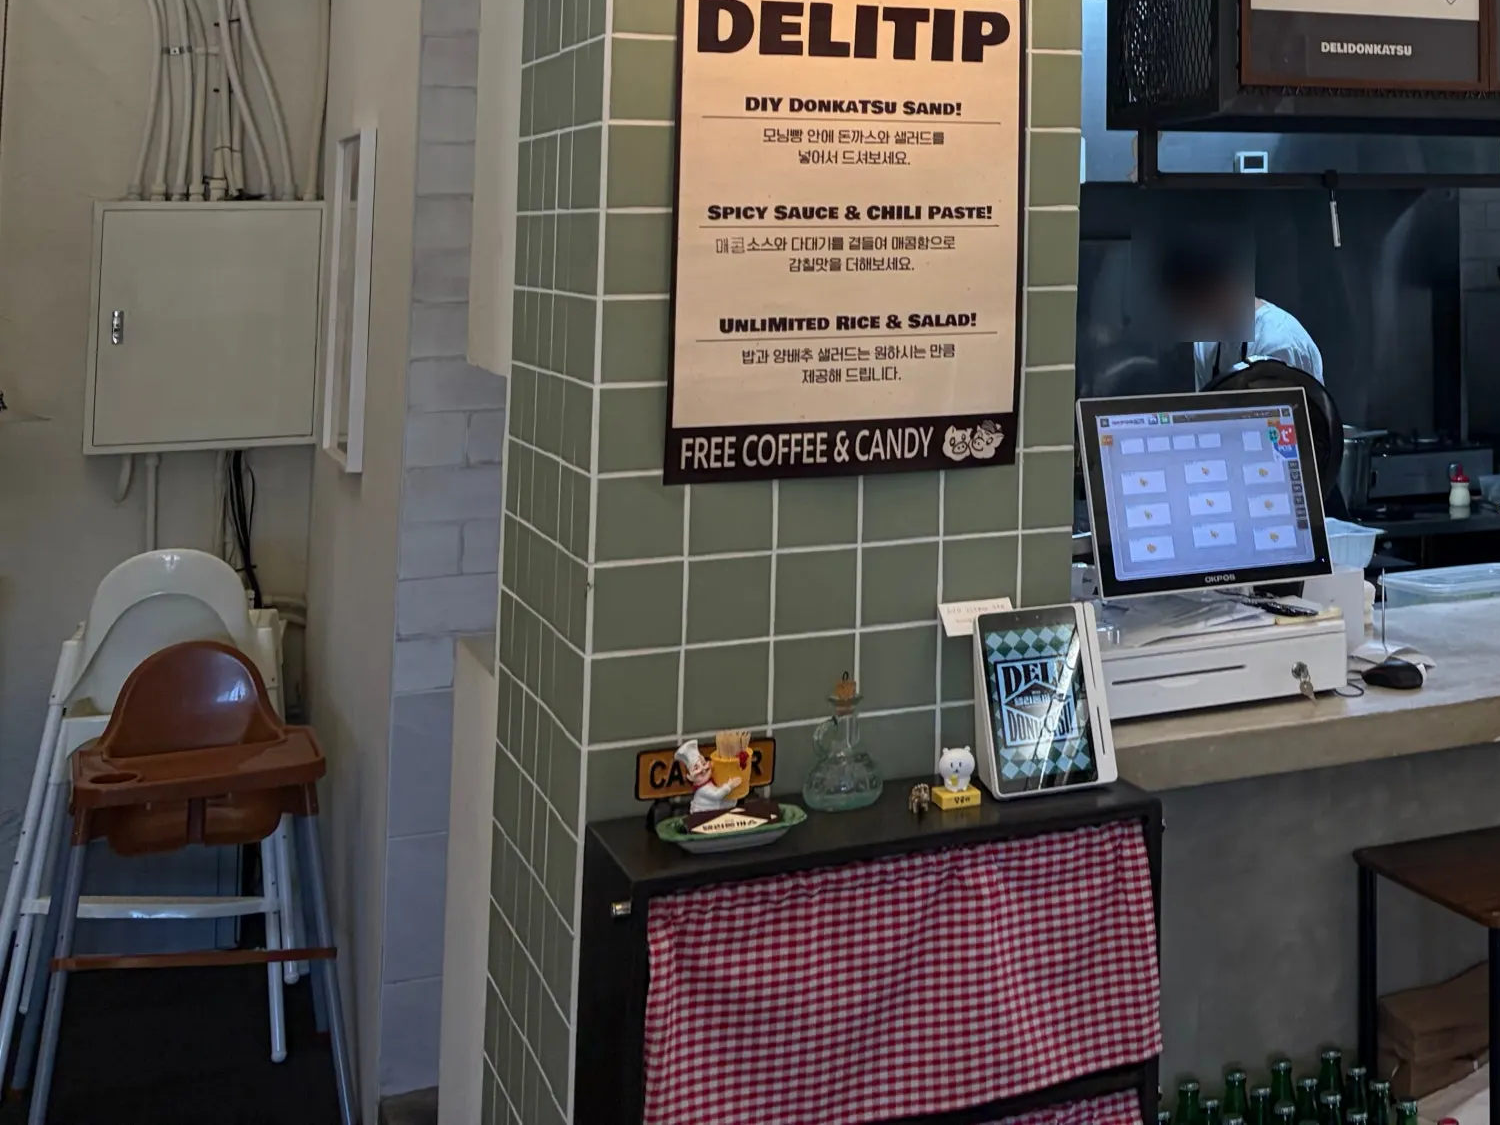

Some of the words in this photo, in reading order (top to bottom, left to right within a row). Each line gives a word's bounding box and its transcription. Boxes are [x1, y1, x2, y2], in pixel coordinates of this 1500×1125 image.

[1320, 41, 1413, 56] DELIDONKATSU
[745, 96, 784, 113] DIY
[789, 97, 897, 115] DONKATSU
[902, 101, 962, 116] SAND!
[762, 128, 804, 144] 모닝빵
[807, 128, 834, 144] 안에
[838, 129, 890, 145] 돈까스와
[894, 130, 945, 146] 샐러드를
[798, 149, 838, 165] 넣어서
[842, 150, 911, 166] 드셔보세요.
[708, 204, 768, 221] SPICY
[774, 204, 839, 221] SAUCE
[844, 204, 861, 221] &
[866, 205, 922, 221] CHILI
[928, 205, 993, 221] PASTE!
[791, 236, 844, 252] 다대기를
[848, 236, 888, 252] 곁들여
[788, 257, 842, 273] 감칠맛을
[846, 256, 915, 273] 더해보세요.
[719, 315, 830, 334] UNLIMITED
[836, 314, 880, 332] RICE
[886, 314, 902, 330] &
[908, 312, 977, 329] SALAD!
[741, 349, 769, 365] 밥과
[773, 348, 814, 364] 양배추
[818, 346, 871, 363] 샐러드는
[874, 345, 927, 361] 원하시는
[929, 344, 956, 360] 만큼
[801, 367, 842, 385] 제공해
[845, 366, 902, 384] 드립니다.
[680, 435, 737, 471] FREE
[742, 431, 828, 467] COFFEE
[833, 430, 850, 463] &
[855, 426, 934, 462] CANDY
